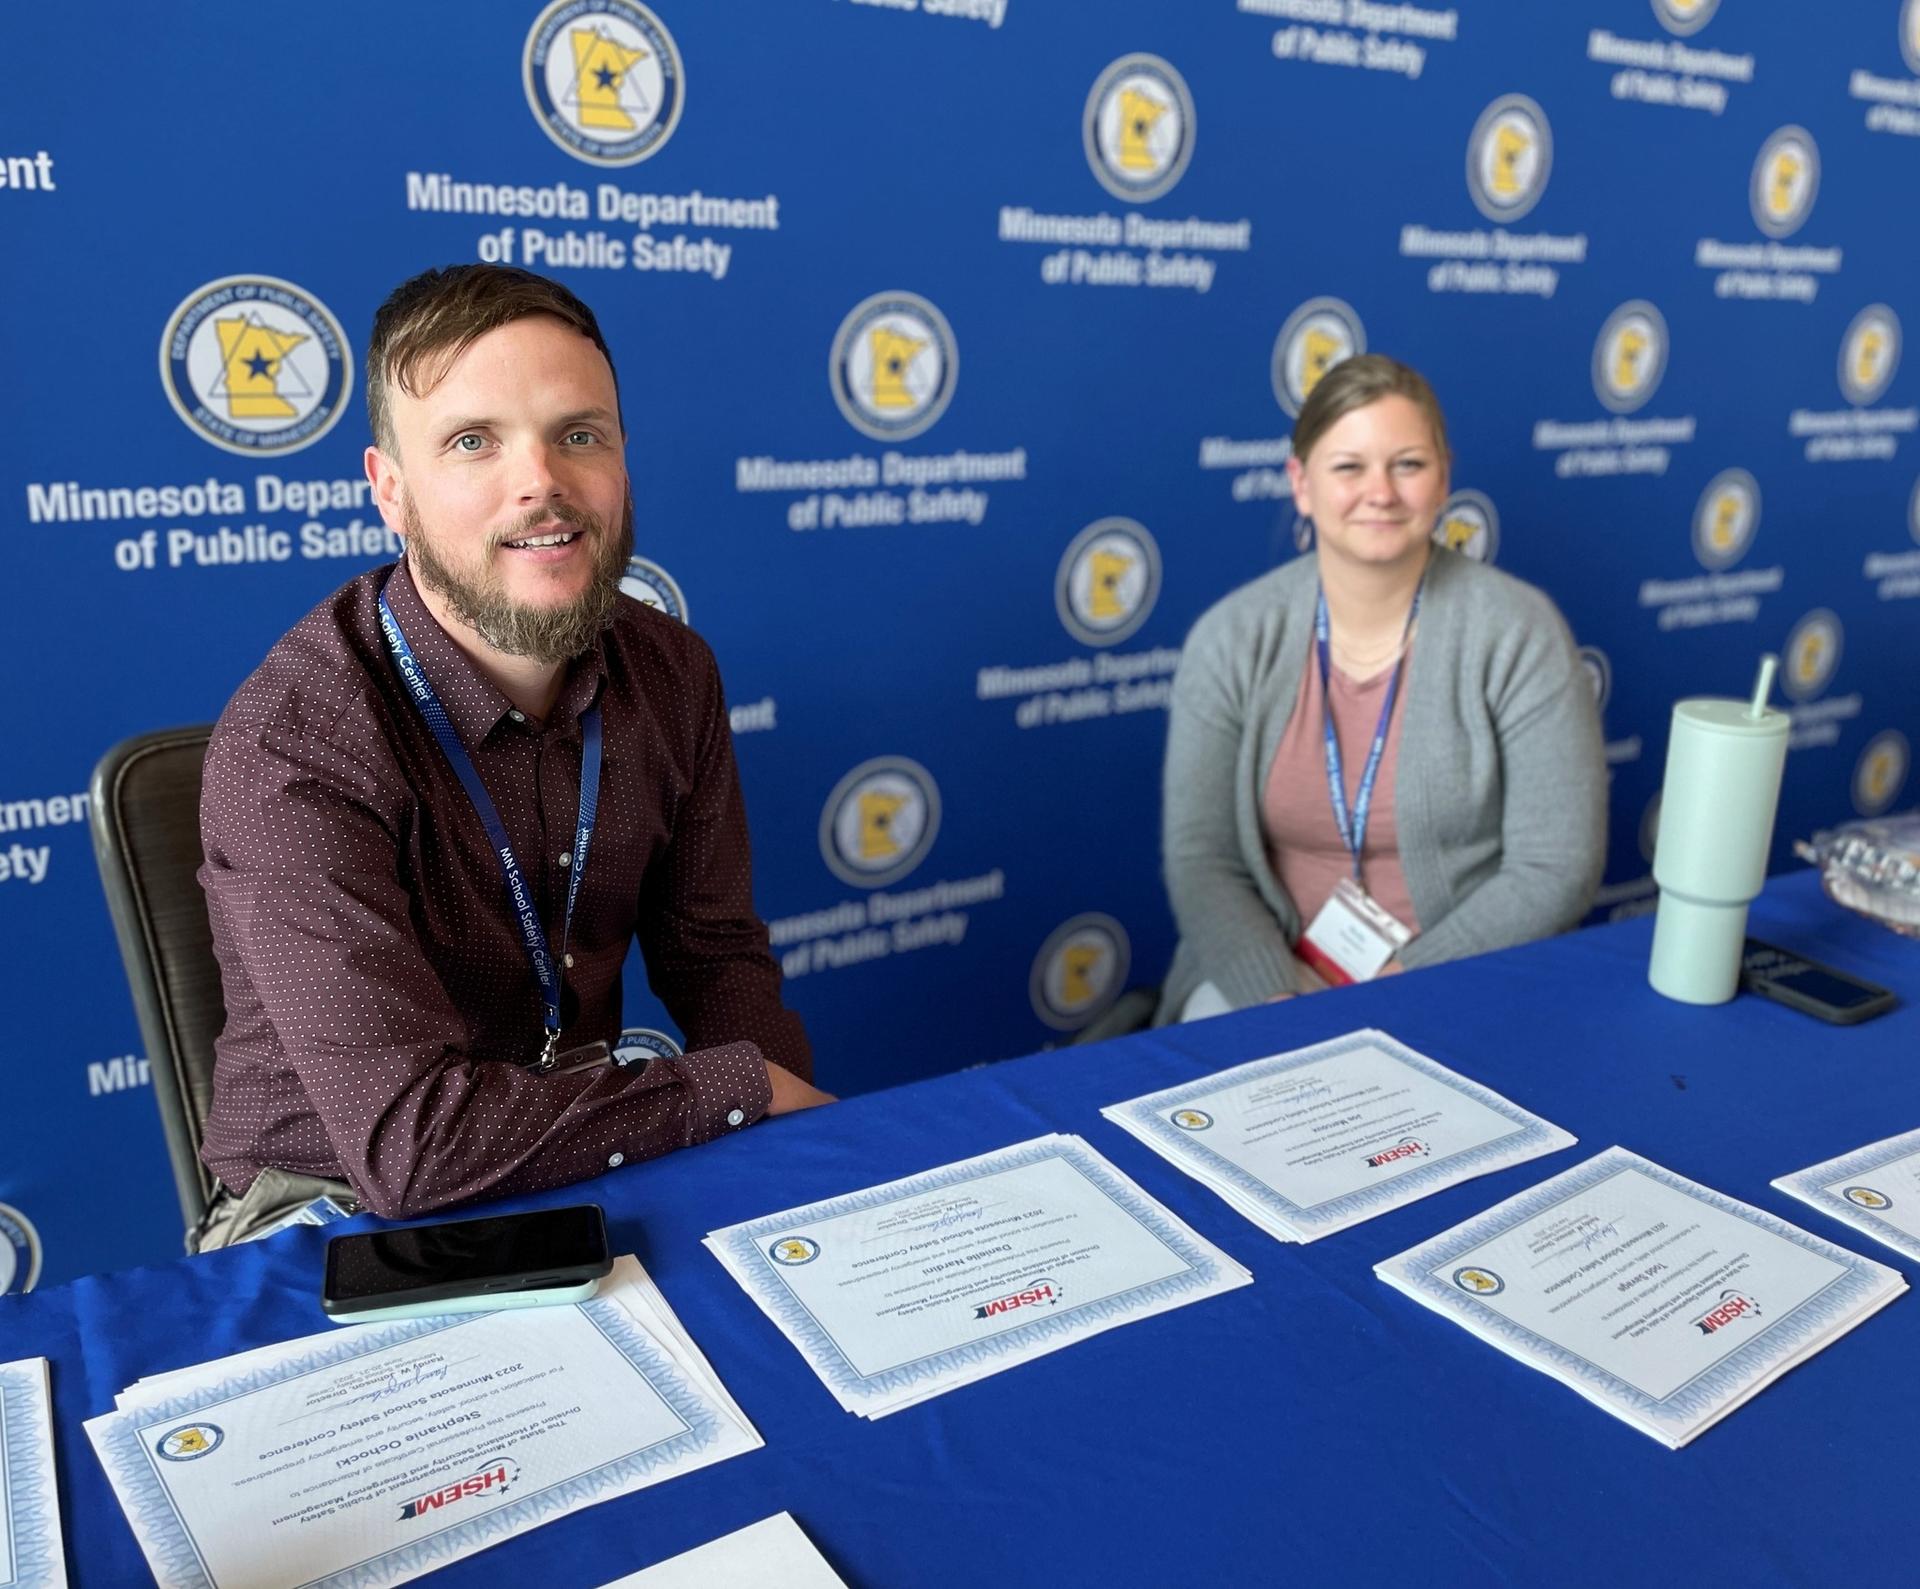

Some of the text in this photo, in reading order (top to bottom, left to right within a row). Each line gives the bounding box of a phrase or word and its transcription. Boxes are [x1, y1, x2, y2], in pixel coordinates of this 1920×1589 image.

[407, 172, 779, 230] Minnesota Department
[999, 206, 1251, 250] Minnesota Department
[478, 228, 731, 280] of Public Safety
[1071, 249, 1142, 286] Public
[1145, 250, 1216, 293] Safety
[171, 287, 234, 360] DEPARTMENT
[259, 287, 310, 317] PUBLIC
[307, 308, 341, 360] SAFETY
[736, 448, 1027, 491] Minnesota Department
[27, 475, 378, 522] Minnesota Depar
[788, 488, 988, 531] of Public Safety
[115, 530, 156, 571] of
[168, 525, 291, 567] Public
[380, 614, 432, 701] Safety Center
[575, 827, 590, 872] Center
[500, 847, 551, 986] MN School Safety Center
[627, 1036, 660, 1049] PUBLIC
[920, 1243, 1013, 1276] Danielle Nardini
[985, 1284, 1054, 1316] HSEM
[1701, 1296, 1752, 1331] HSEM
[411, 1354, 444, 1369] Randy
[257, 1362, 524, 1460] 2023 Minnesota School Safety Conference
[303, 1388, 347, 1406] Director
[334, 1409, 481, 1468] Stephanie Ochocki
[518, 1427, 546, 1441] State
[546, 1420, 566, 1430] The
[270, 1406, 581, 1525] Division of Homeland Security and Emergency Management
[386, 1462, 450, 1490] Department
[451, 1443, 505, 1466] Minnesota
[336, 1492, 373, 1510] Public
[373, 1487, 386, 1495] of
[416, 1466, 506, 1515] HSEM
[297, 1505, 336, 1524] Safety
